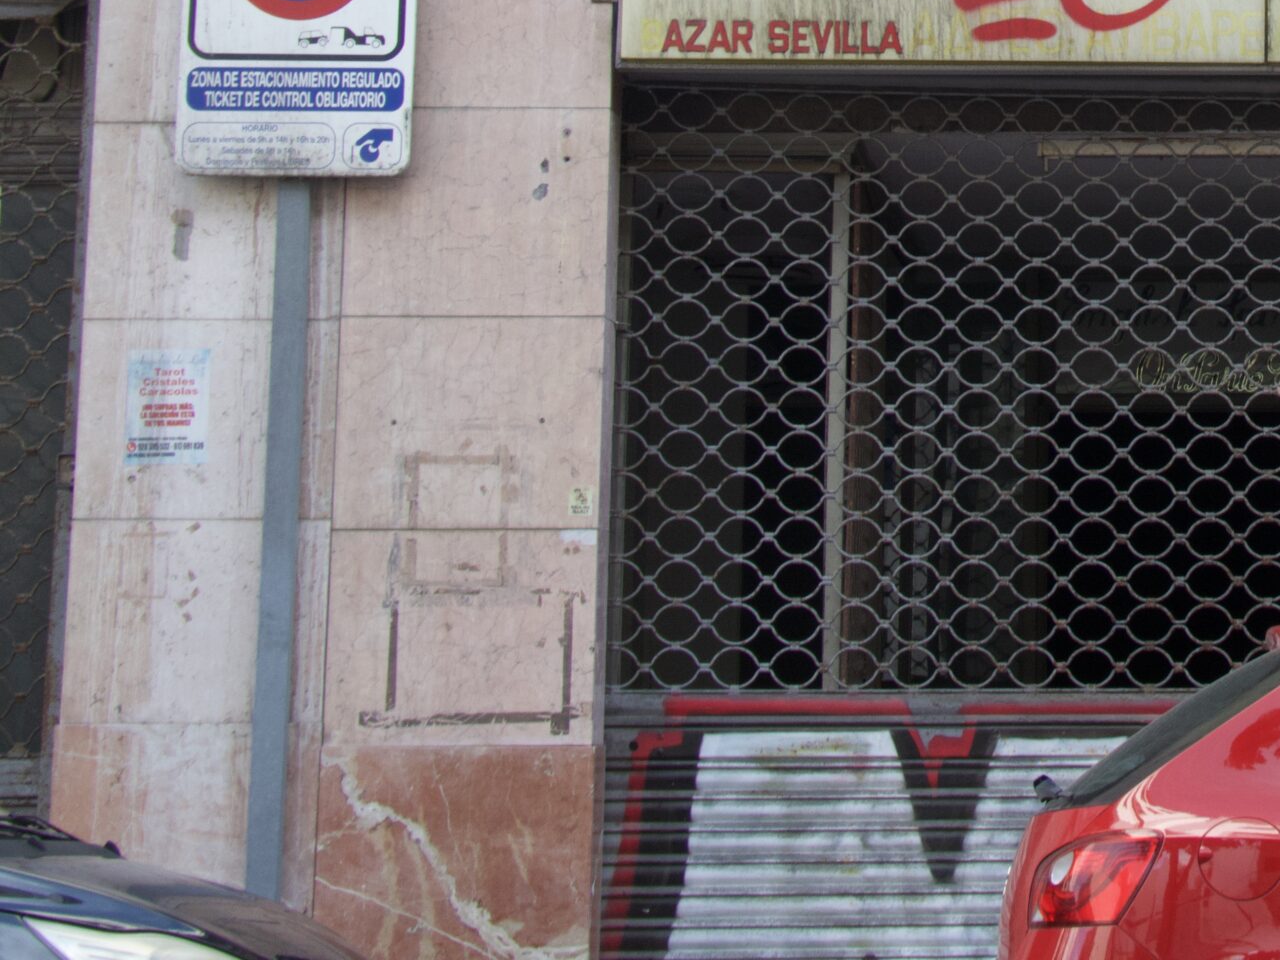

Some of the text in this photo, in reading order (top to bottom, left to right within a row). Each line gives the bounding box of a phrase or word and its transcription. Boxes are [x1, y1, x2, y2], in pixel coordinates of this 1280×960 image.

[767, 19, 903, 54] SEVILLA
[191, 70, 400, 89] ZONA DE ESTACIONAMIENTO REGULADO
[204, 91, 386, 109] TICKET DE CONTROL OBLIGATORIO
[154, 368, 186, 376] Tarot
[143, 377, 196, 386] Cristales
[139, 387, 199, 397] Caracolas
